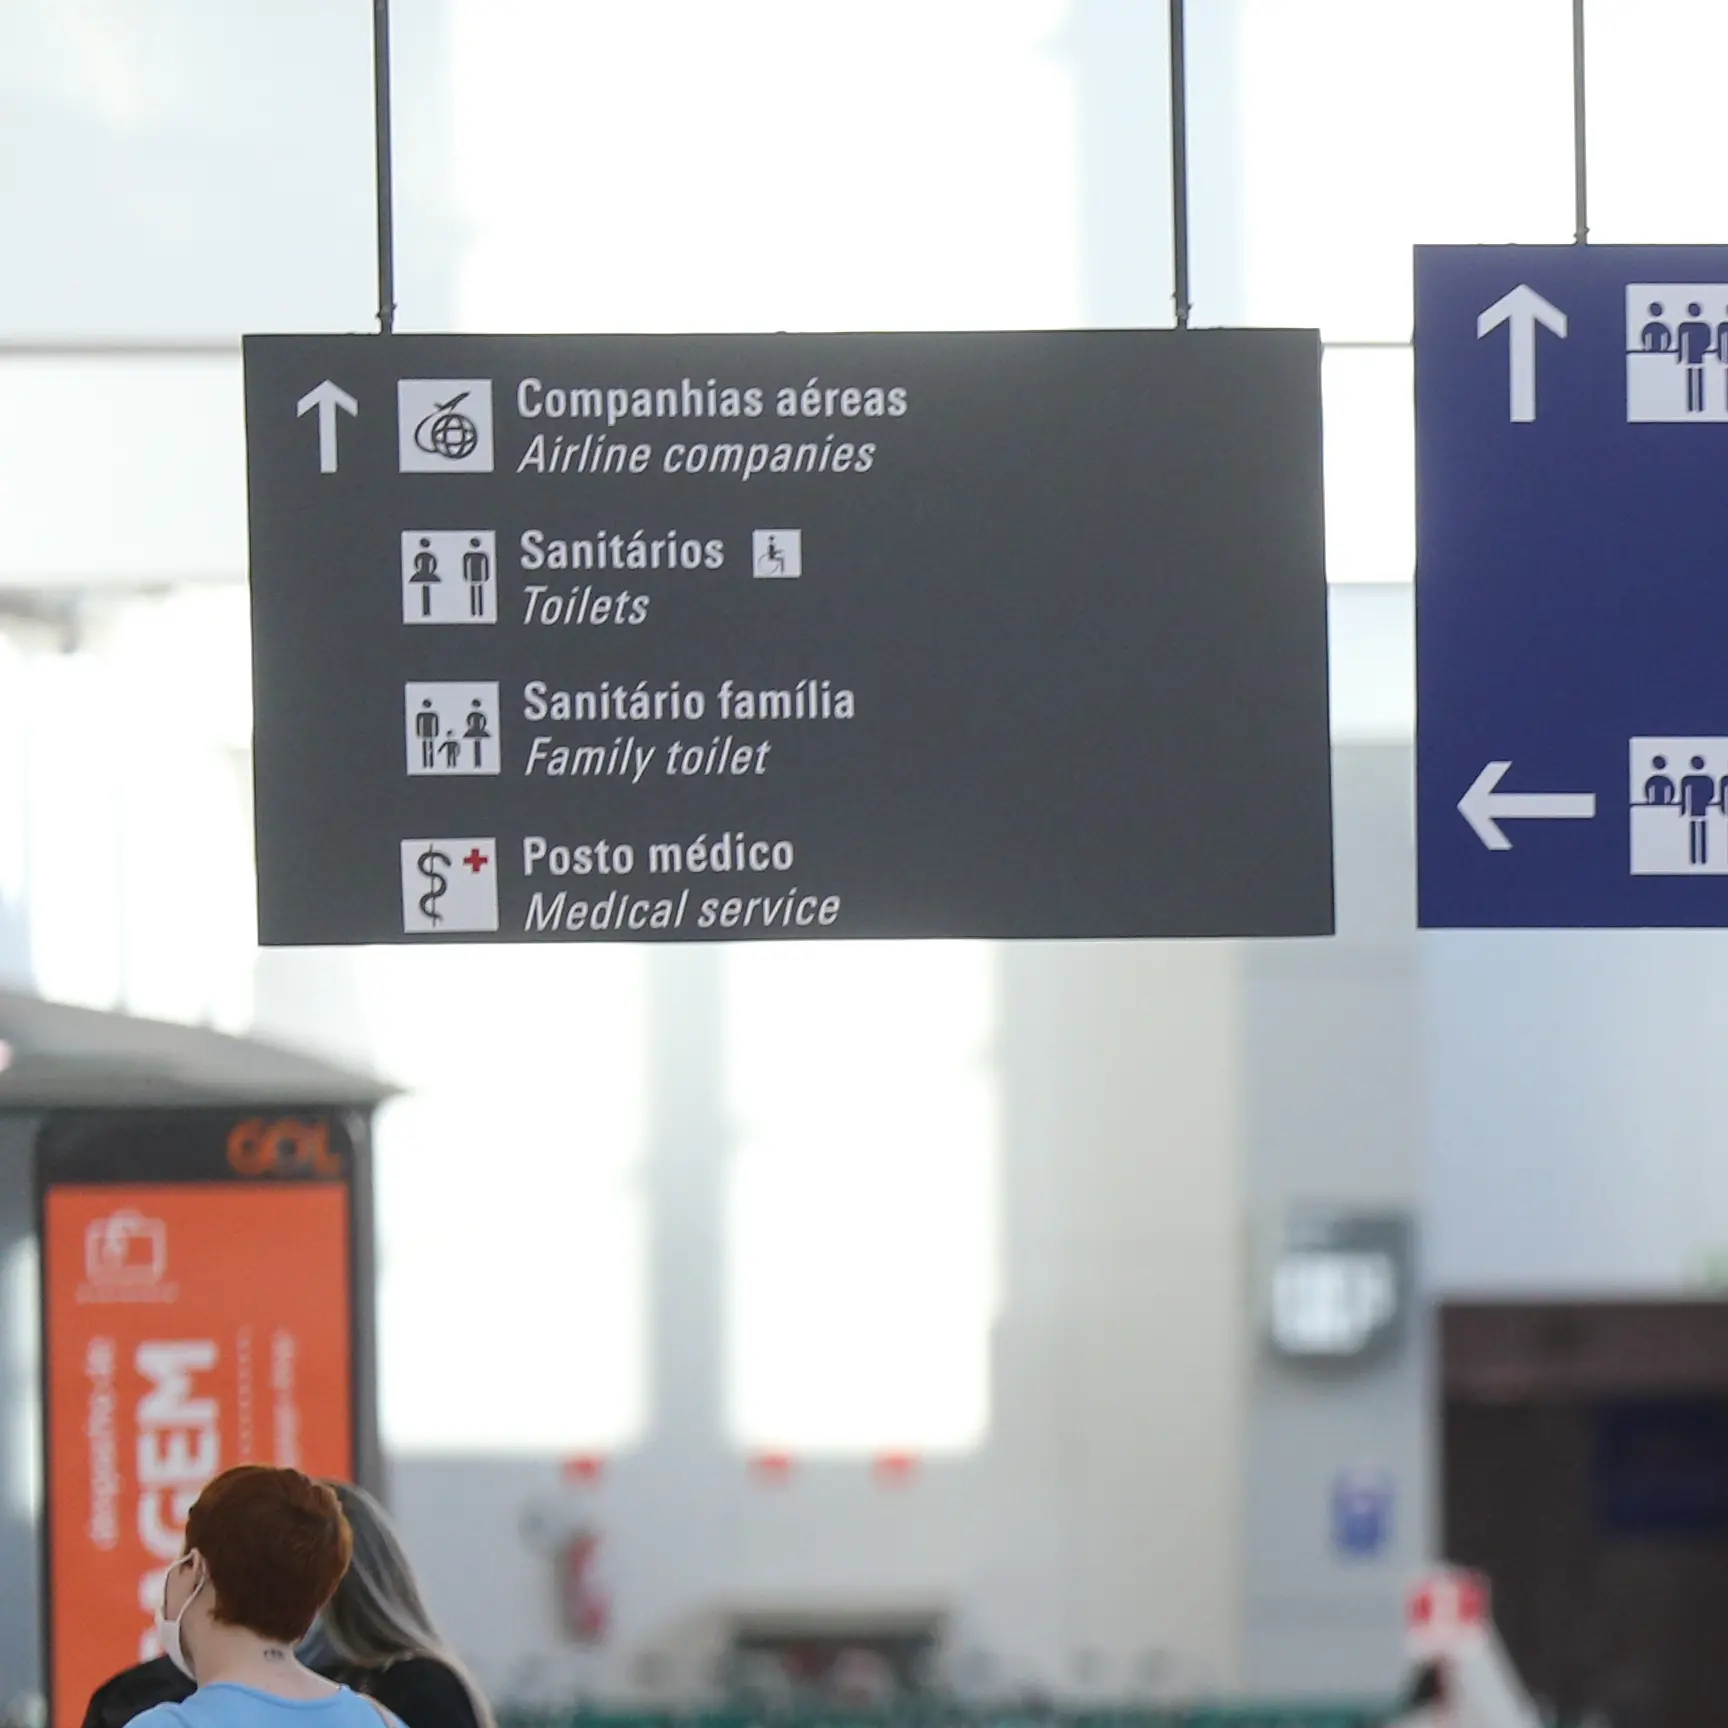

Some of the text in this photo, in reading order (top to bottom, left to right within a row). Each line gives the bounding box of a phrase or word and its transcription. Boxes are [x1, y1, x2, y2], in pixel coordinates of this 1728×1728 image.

[518, 378, 907, 425] Companhias aéreas
[517, 434, 875, 481] Airline companies
[521, 530, 723, 569] Sanitários
[525, 586, 649, 624] Toilets
[524, 680, 854, 720] Sanitário família
[525, 736, 770, 783] Family toilet
[524, 832, 793, 875] Posto médico
[525, 888, 840, 931] Medical service
